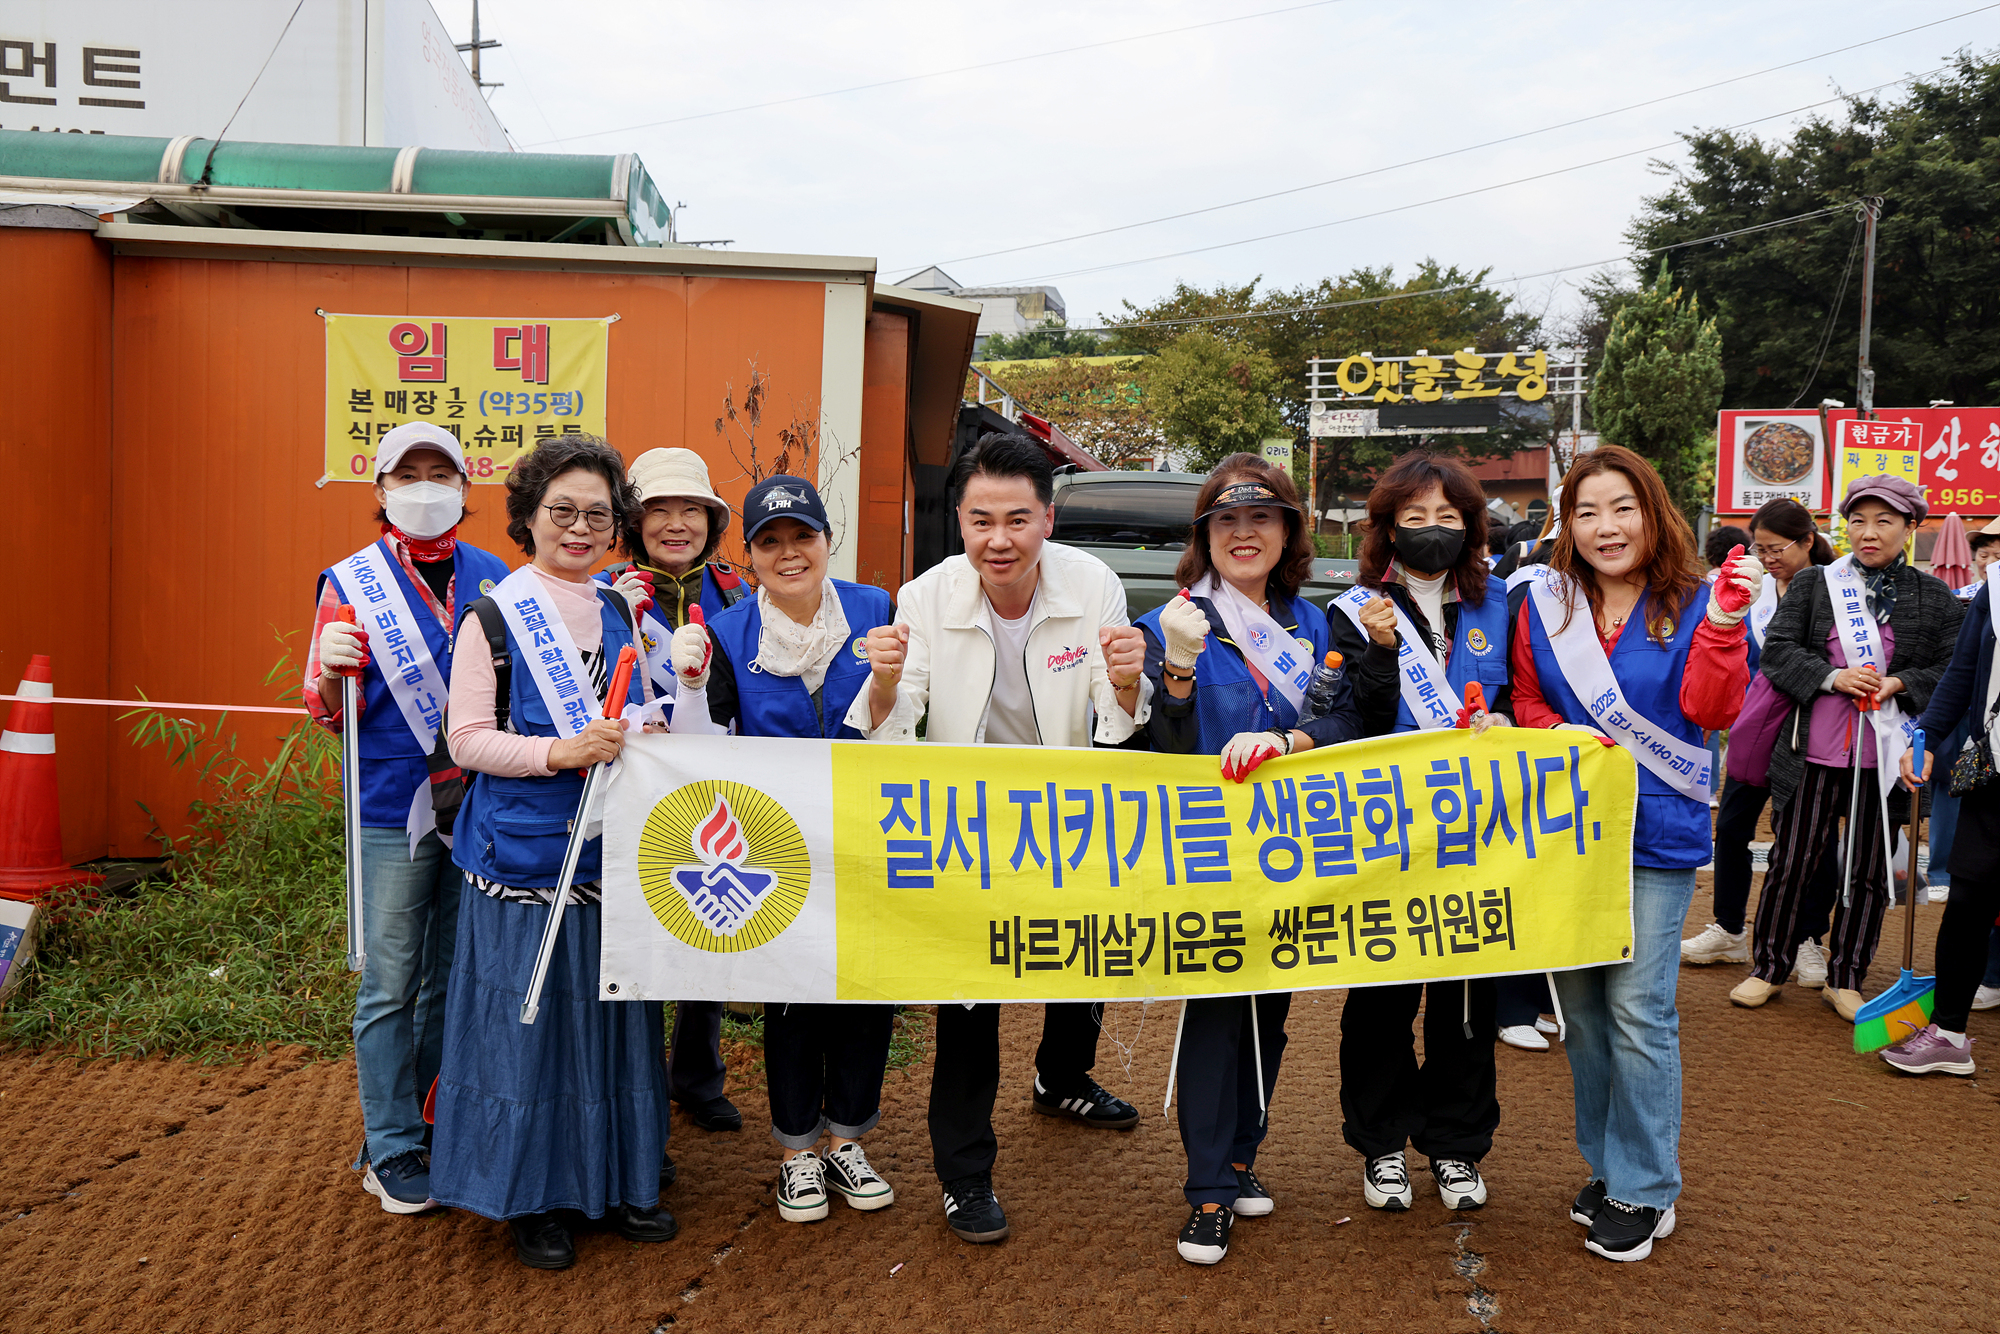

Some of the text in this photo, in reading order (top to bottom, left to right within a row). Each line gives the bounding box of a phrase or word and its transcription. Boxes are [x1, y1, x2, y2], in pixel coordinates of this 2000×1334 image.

[347, 388, 374, 413] 본
[384, 390, 438, 415] 매장
[478, 390, 584, 417] (약35평)
[1851, 424, 1913, 448] 현금가
[767, 500, 792, 512] LAH
[514, 597, 555, 648] 법질서
[539, 646, 580, 699] 확립을
[1590, 687, 1617, 717] 2025
[1607, 710, 1695, 776] 탄소중립
[879, 746, 1601, 890] 질서 지키기를 생활화 합시다.
[989, 887, 1517, 979] 바르게살기운동 쌍문1동 위원회
